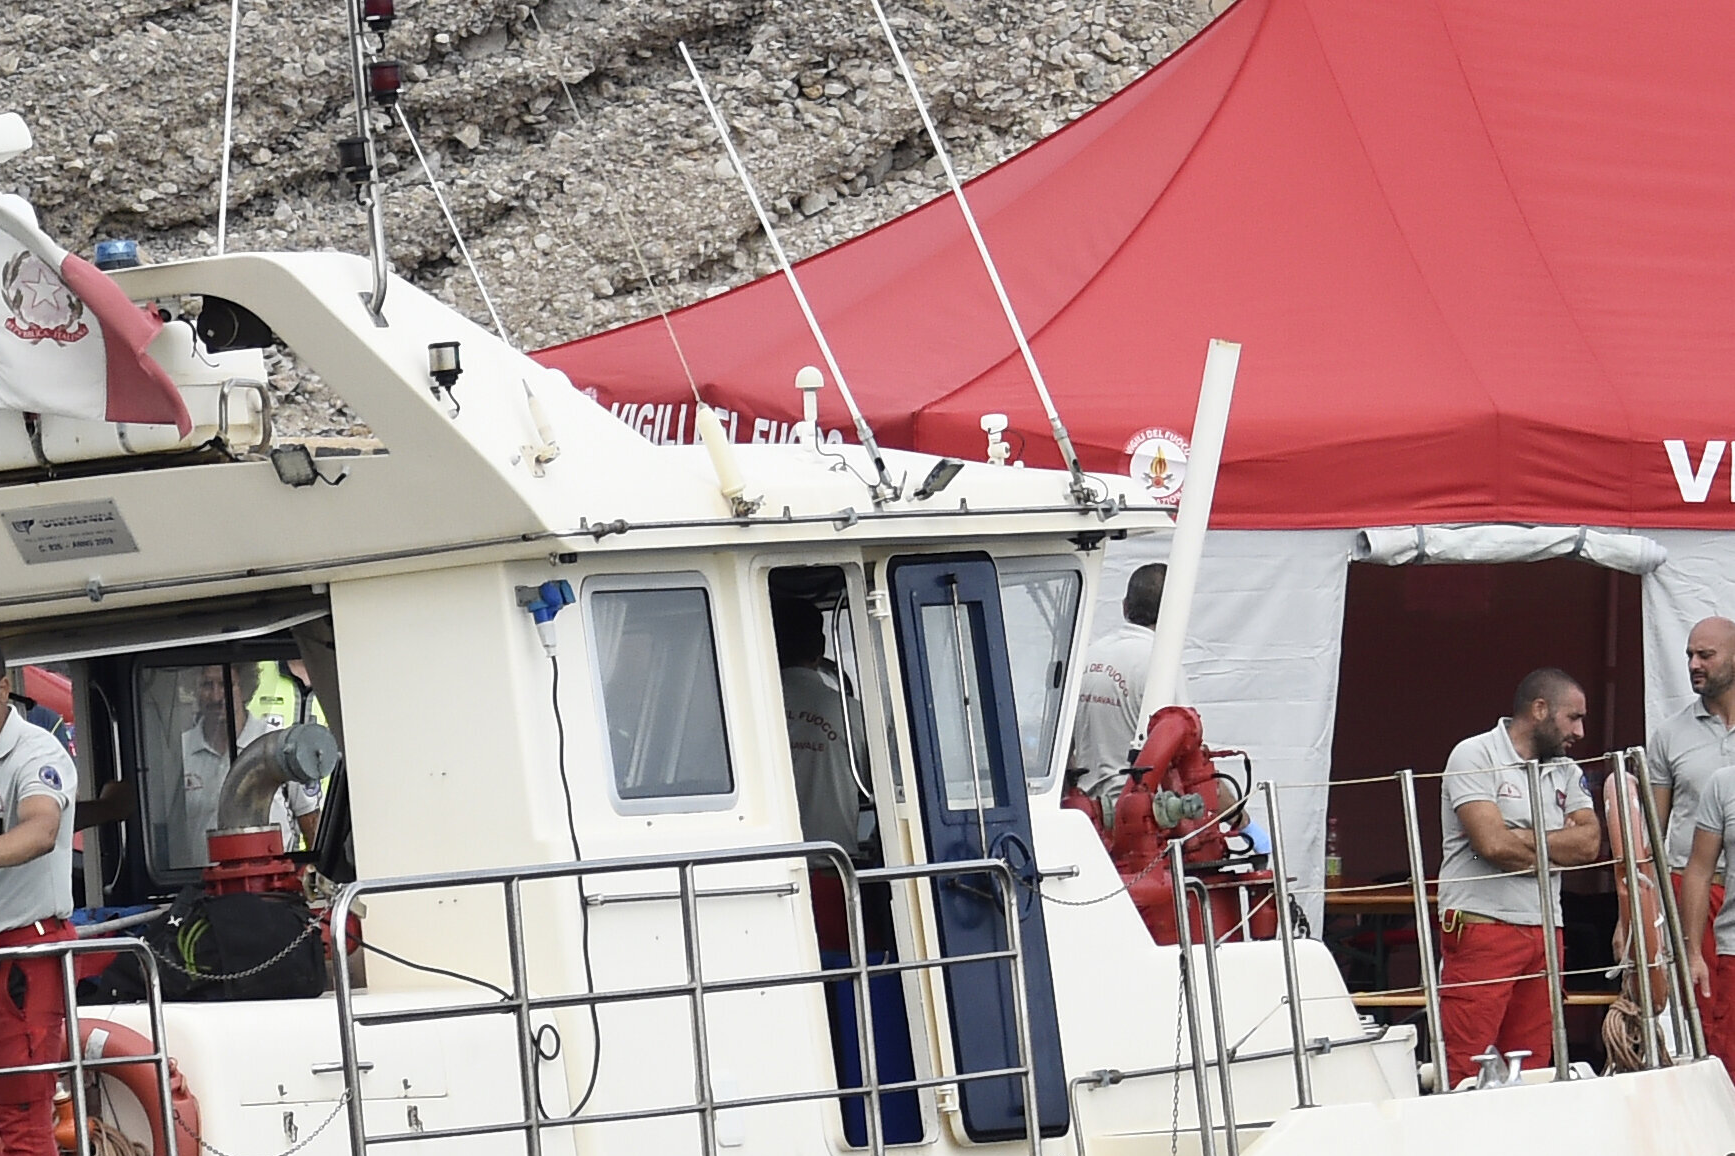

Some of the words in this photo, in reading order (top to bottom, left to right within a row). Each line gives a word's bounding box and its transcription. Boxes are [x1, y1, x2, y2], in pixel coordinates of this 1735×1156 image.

[1145, 429, 1164, 439] DEL
[1663, 439, 1735, 503] V
[798, 711, 838, 742] FUOCO
